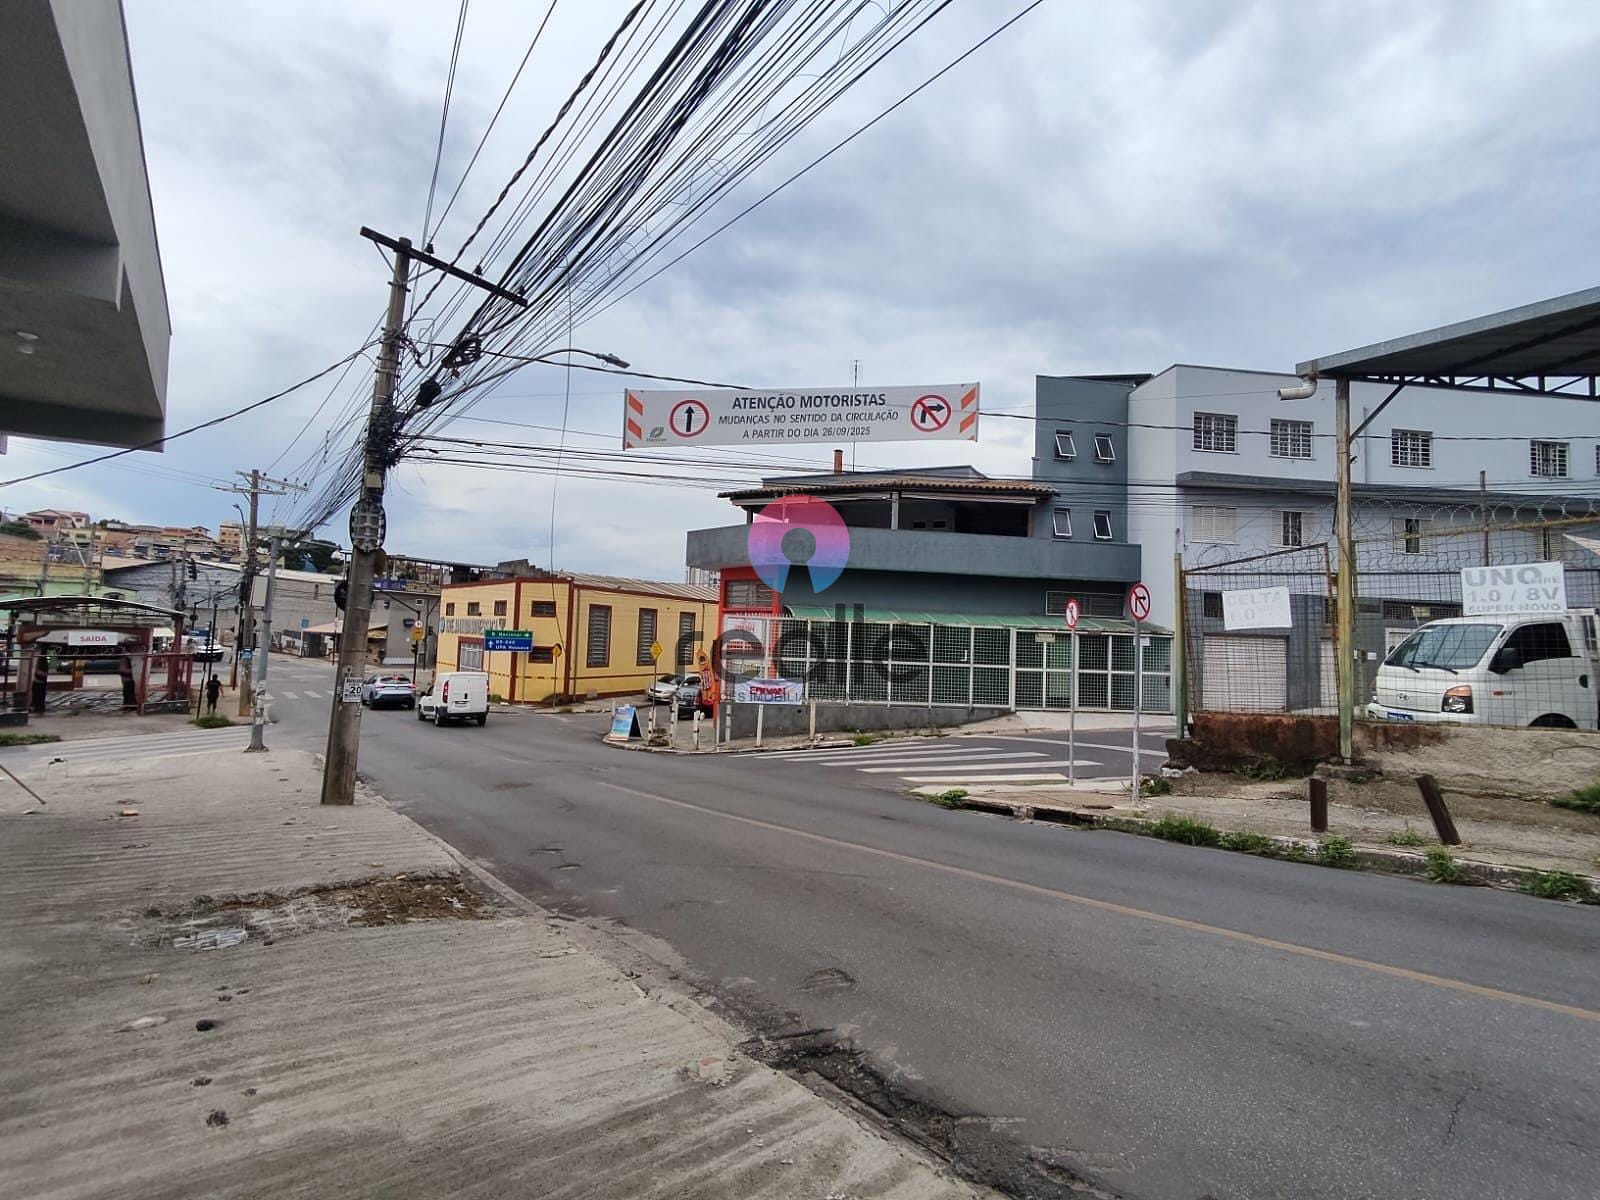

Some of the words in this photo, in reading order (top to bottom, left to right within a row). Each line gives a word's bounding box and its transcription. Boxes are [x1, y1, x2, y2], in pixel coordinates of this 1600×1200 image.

[732, 393, 795, 413] ATENÇÃO
[800, 393, 886, 408] MOTORISTAS
[718, 414, 770, 425] MUDANÇAS
[773, 414, 786, 423] NO
[790, 413, 827, 423] SENTIDO
[831, 413, 842, 422] DA
[846, 409, 899, 421] CIRCULAÇÃO
[743, 429, 750, 439] A
[752, 428, 785, 439] PARTIR
[787, 427, 801, 438] DO
[804, 427, 819, 437] DIA
[822, 426, 871, 437] 26/09/2025
[1465, 567, 1542, 586] UNO
[1467, 589, 1501, 602] 1.0
[1526, 587, 1560, 601] 8V
[1469, 603, 1515, 613] SUPER
[1519, 602, 1561, 612] NOVO
[350, 686, 361, 694] 20
